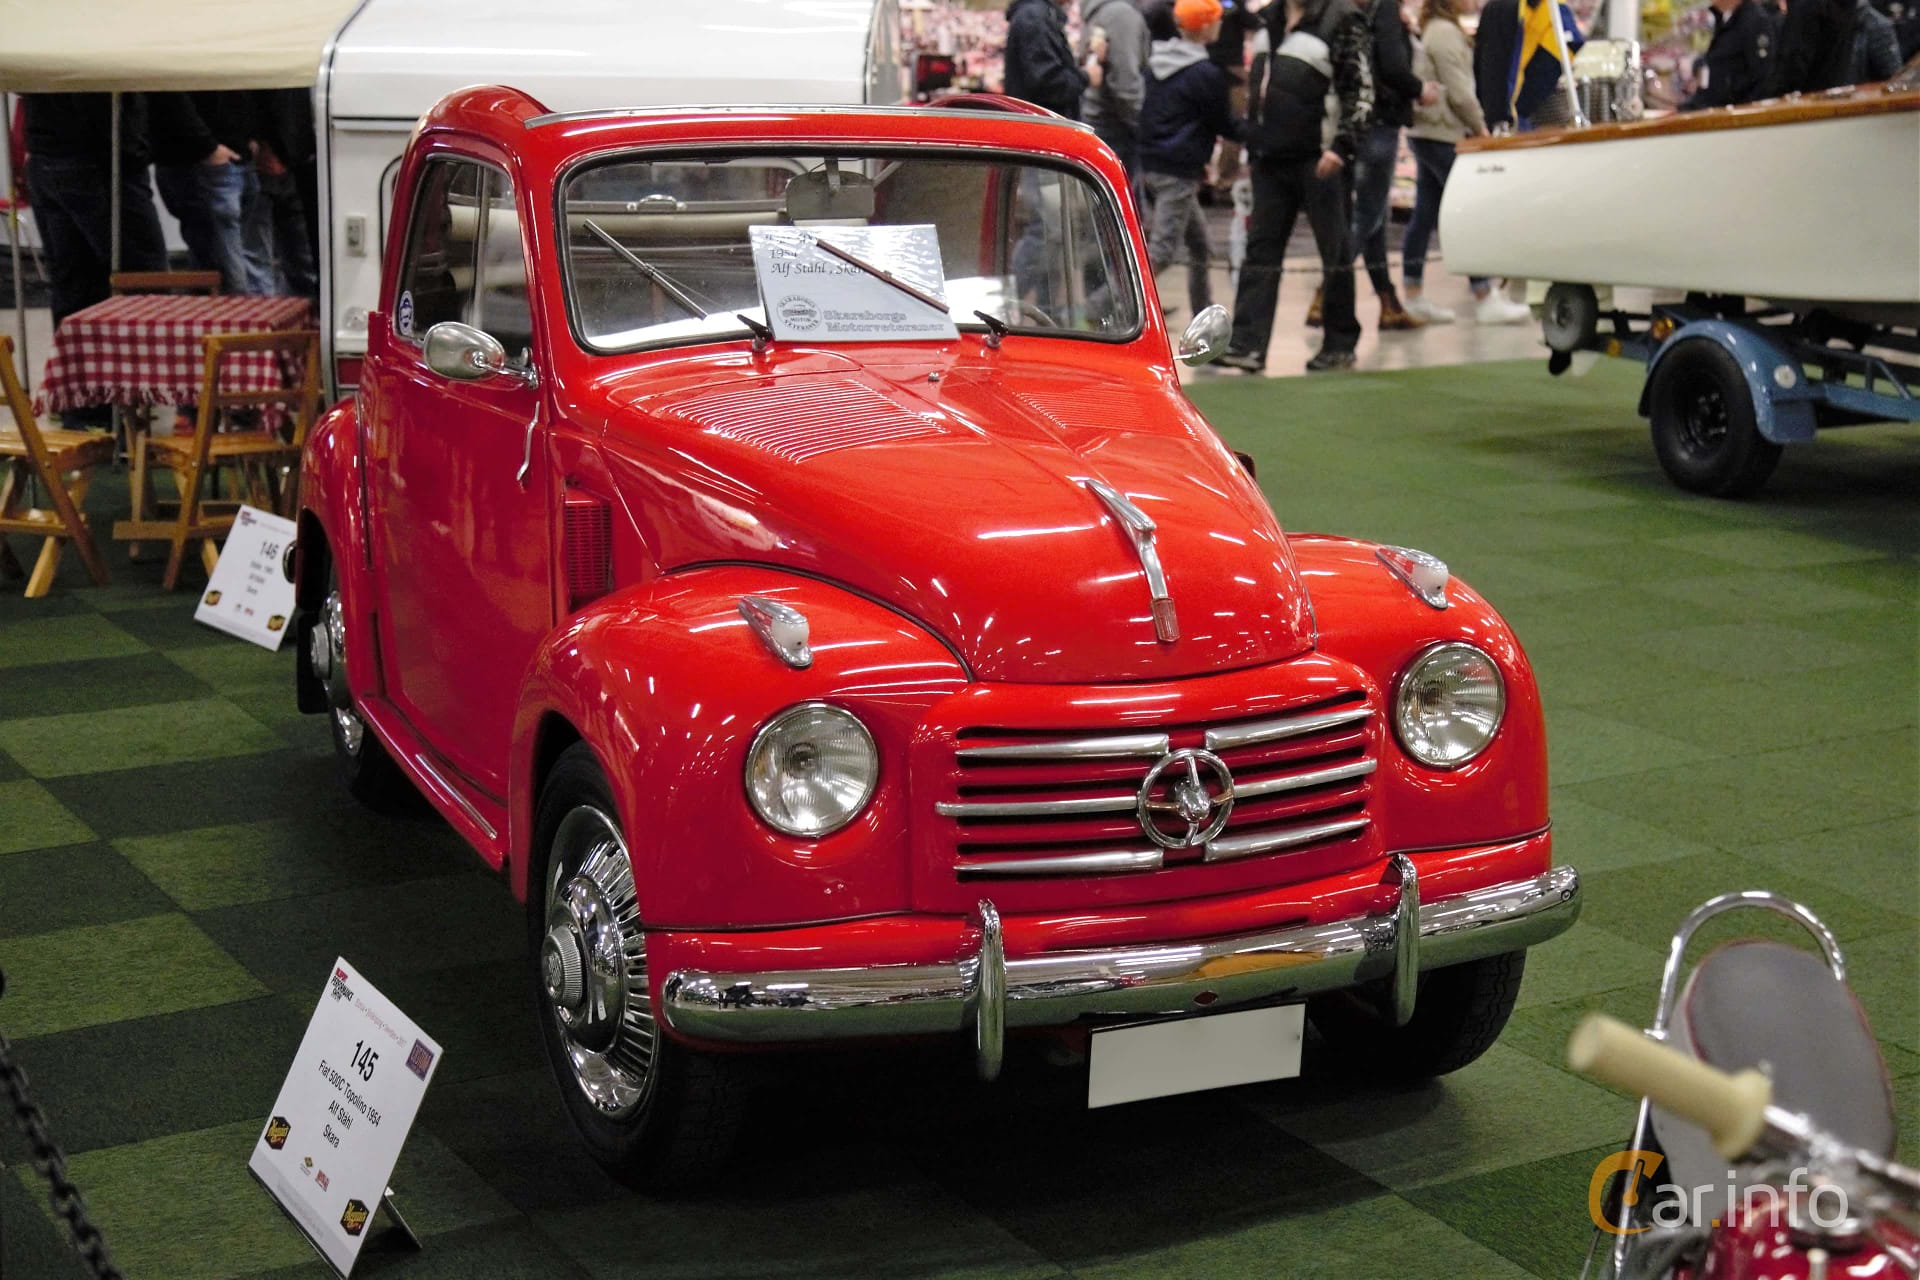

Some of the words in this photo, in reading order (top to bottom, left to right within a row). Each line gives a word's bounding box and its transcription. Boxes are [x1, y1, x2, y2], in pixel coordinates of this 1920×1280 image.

[771, 261, 792, 277] Alf
[823, 310, 907, 323] Skaraborgs
[351, 1040, 379, 1082] 145
[319, 1060, 331, 1078] Fiat
[329, 1070, 346, 1091] 500C
[344, 1082, 367, 1114] Topolino
[366, 1106, 382, 1127] 1954
[328, 1099, 341, 1116] Alf
[323, 1124, 341, 1148] Skara
